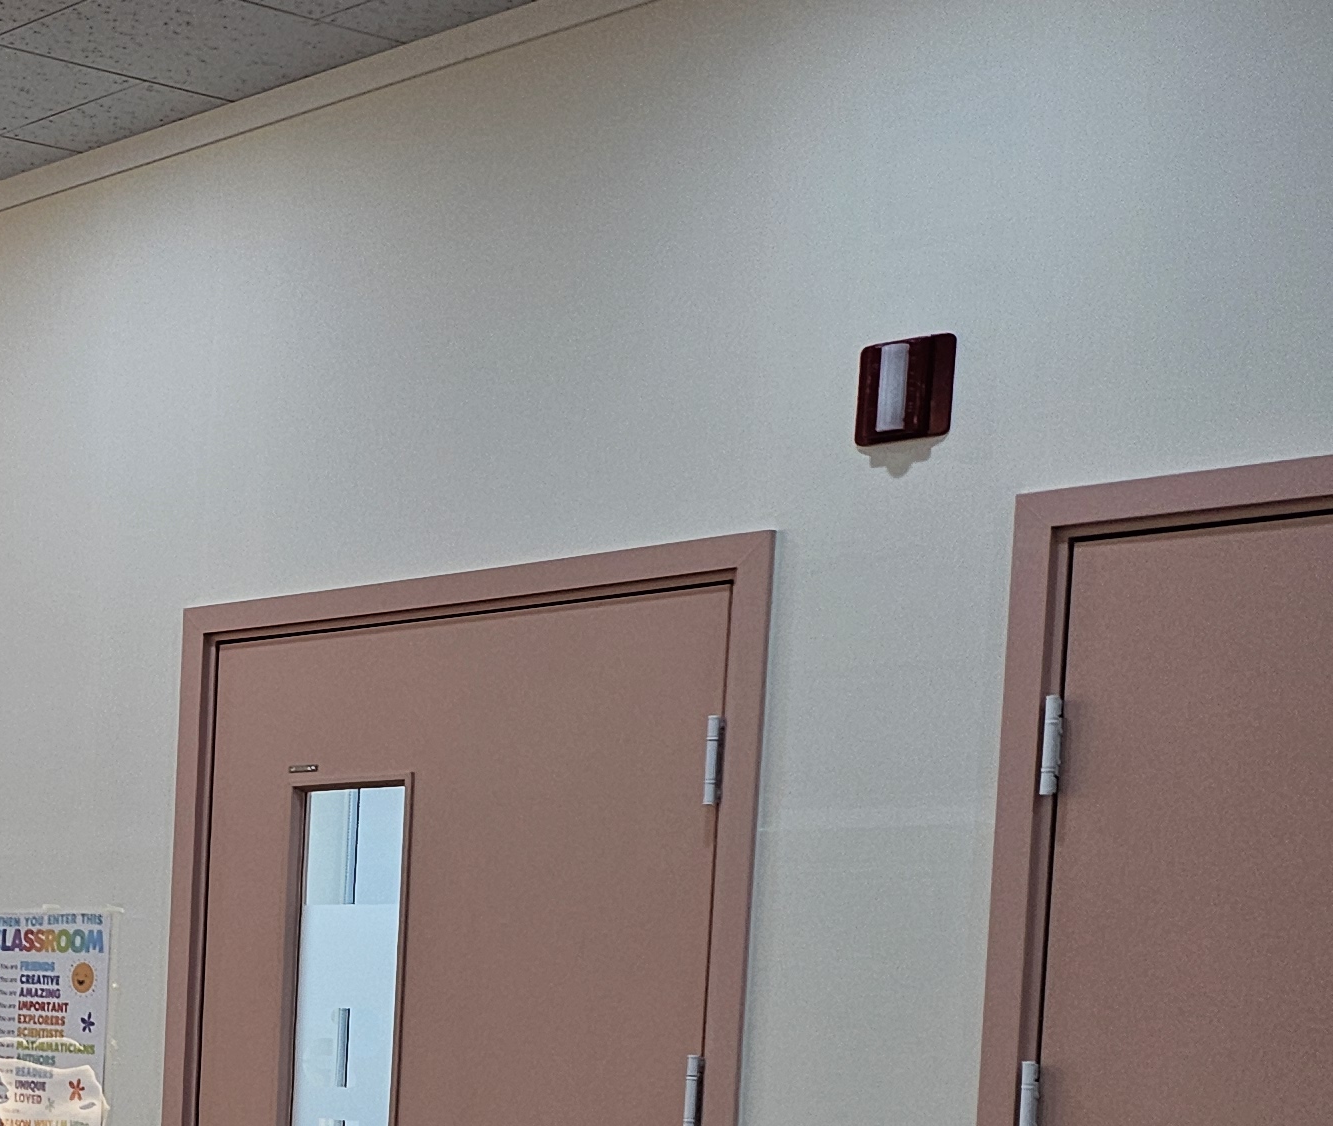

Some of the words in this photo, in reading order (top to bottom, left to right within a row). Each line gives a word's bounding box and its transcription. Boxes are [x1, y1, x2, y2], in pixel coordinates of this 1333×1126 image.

[24, 916, 44, 927] YOU
[47, 914, 77, 925] ENTER
[81, 913, 103, 925] THIS
[19, 974, 60, 986] CREATIVE
[19, 987, 61, 999] AMAZING
[18, 1000, 69, 1013] IMPORTANT
[17, 1014, 65, 1026] EXPLORERS
[17, 1027, 64, 1038] SCIENTISTS
[16, 1041, 95, 1055] MATHEMATICIANS
[15, 1080, 46, 1092] UNIQUE
[15, 1093, 42, 1104] LOVED
